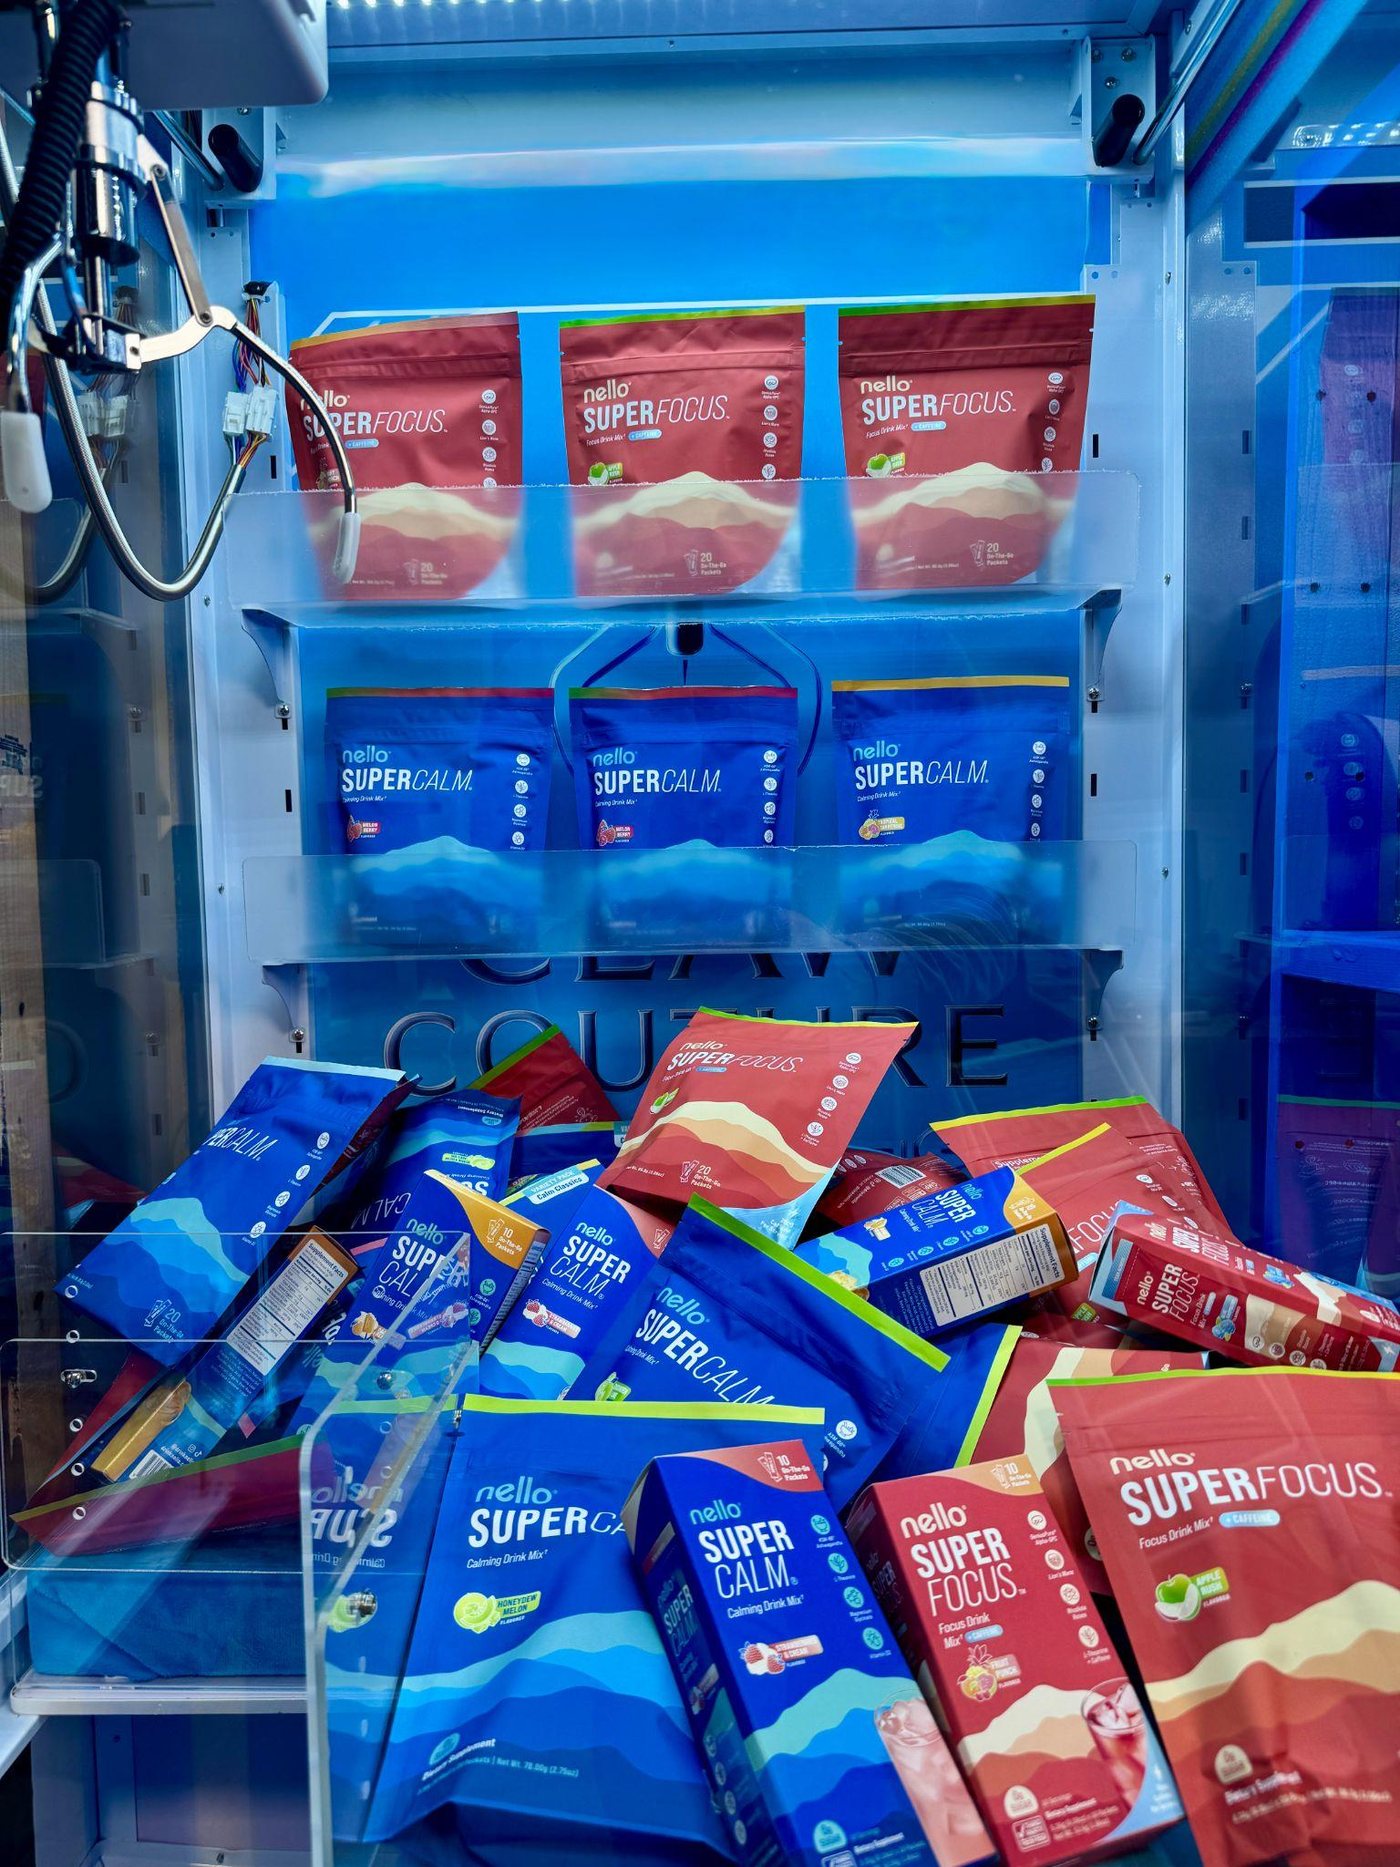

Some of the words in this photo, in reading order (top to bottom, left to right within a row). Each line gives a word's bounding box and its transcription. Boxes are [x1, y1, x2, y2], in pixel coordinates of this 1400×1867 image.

[583, 379, 632, 403] nello
[860, 376, 912, 394] nello
[300, 389, 350, 411] nllo
[700, 552, 712, 562] 20
[987, 543, 999, 552] 20
[343, 745, 391, 764] nello
[593, 747, 638, 767] nello
[853, 740, 901, 762] nello
[680, 1040, 728, 1051] nello
[699, 1165, 712, 1175] 20
[537, 1188, 555, 1201] Calm
[554, 1176, 583, 1192] Classics
[961, 1183, 983, 1200] nello
[912, 1199, 951, 1229] CALM
[935, 1189, 977, 1223] SUPER
[406, 1218, 446, 1245] nello
[503, 1227, 514, 1239] 10
[576, 1221, 616, 1249] nello
[562, 1235, 632, 1284] SUPER
[1039, 1227, 1056, 1263] Supplement
[1051, 1262, 1061, 1279] Facts
[549, 1255, 611, 1299] CALM
[1137, 1270, 1154, 1306] nello
[1152, 1263, 1183, 1314] SUPER
[542, 1278, 567, 1296] Calming
[566, 1290, 583, 1304] Drink
[1169, 1271, 1199, 1322] FOCUS
[165, 1307, 181, 1324] 20
[656, 1287, 711, 1326] nello
[776, 1454, 790, 1466] 10
[1004, 1462, 1018, 1475] 10
[1109, 1448, 1196, 1476] nello
[475, 1476, 558, 1505] nello
[690, 1500, 741, 1525] nello
[900, 1502, 967, 1539] nello
[699, 1520, 794, 1563] SUPER
[1139, 1531, 1168, 1550] Focus
[1169, 1523, 1194, 1541] Drink
[1232, 1512, 1274, 1525] CAFFEINE
[467, 1552, 502, 1569] Calming
[503, 1551, 527, 1565] Drink
[910, 1527, 1011, 1578] SUPER
[715, 1554, 797, 1598] CALM
[1195, 1570, 1222, 1587] APPLE
[497, 1592, 539, 1610] HONEYDEW
[927, 1563, 1021, 1617] FOCUS
[1200, 1581, 1224, 1597] RUSH
[502, 1602, 529, 1617] MELON
[727, 1602, 764, 1619] Calming
[763, 1598, 787, 1612] Drink
[938, 1621, 966, 1635] Focus
[966, 1612, 990, 1627] Drink
